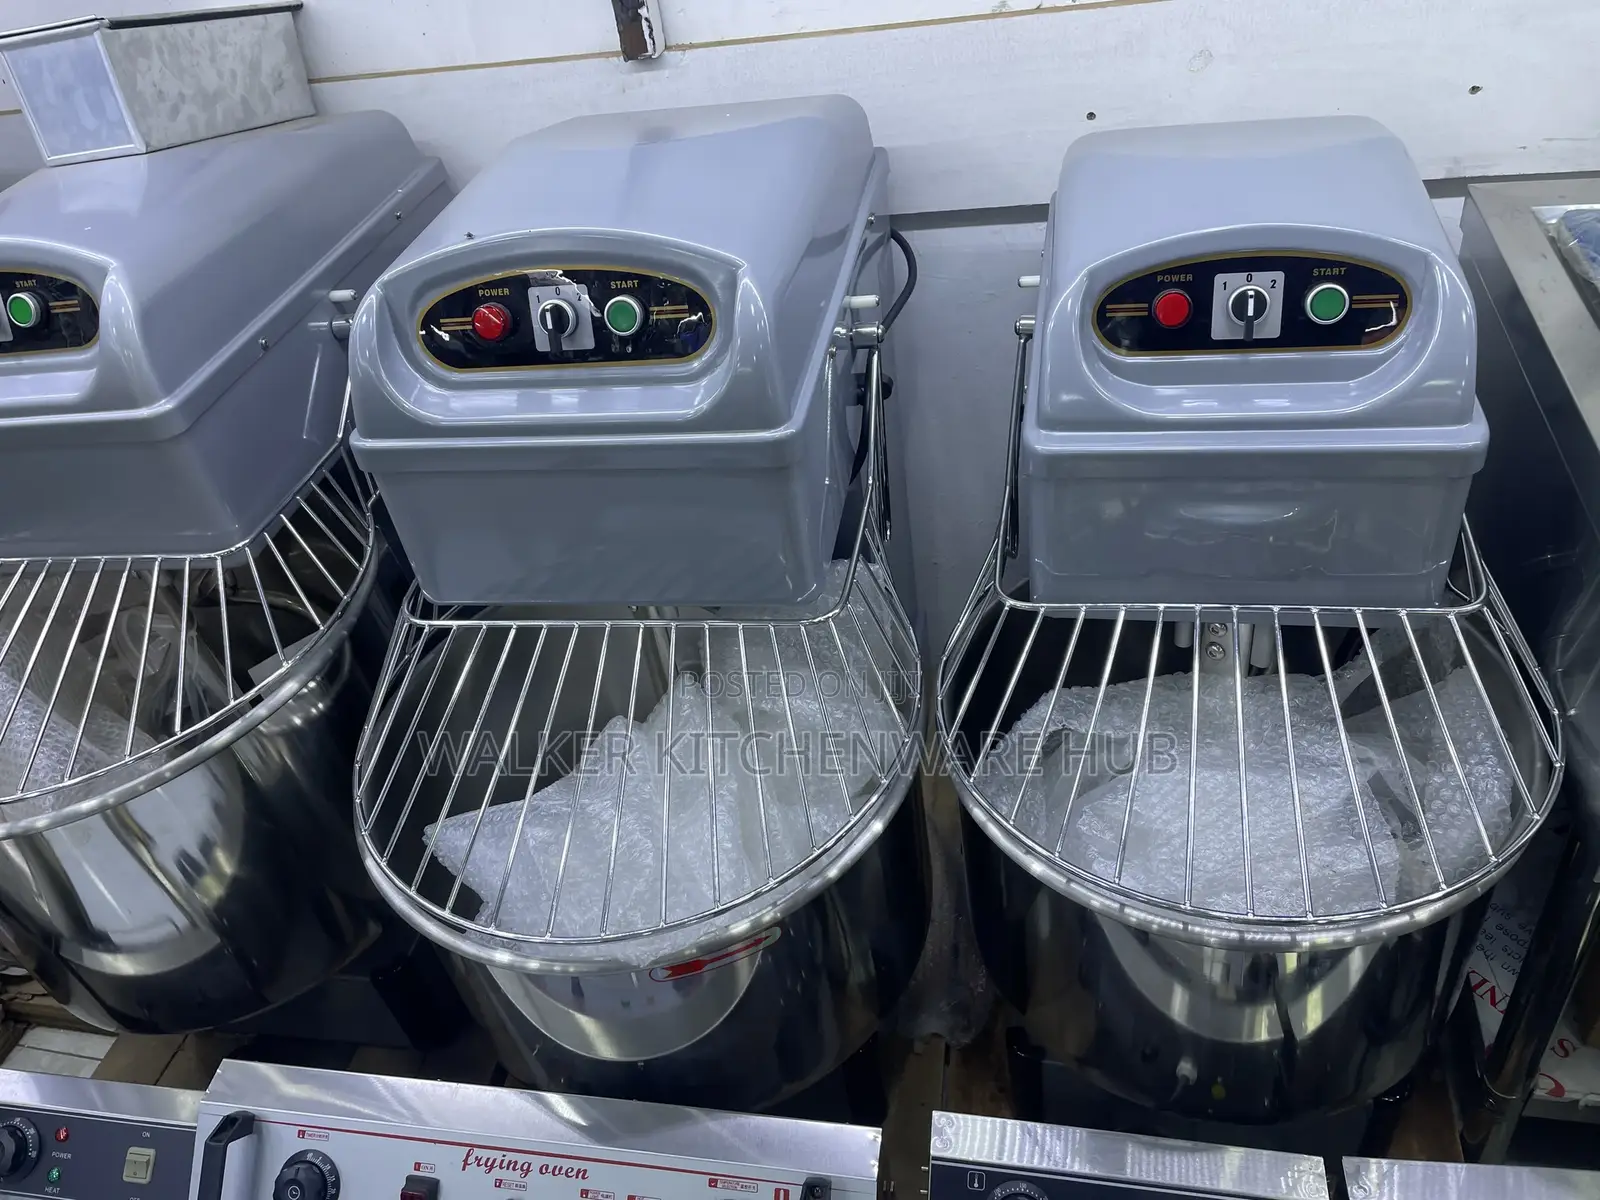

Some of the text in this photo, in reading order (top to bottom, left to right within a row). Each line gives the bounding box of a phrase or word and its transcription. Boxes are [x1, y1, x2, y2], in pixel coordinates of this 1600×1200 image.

[1312, 267, 1347, 277] START
[1157, 273, 1193, 283] POWER
[1223, 273, 1277, 291] 1 0 2
[15, 279, 37, 288] START
[610, 279, 639, 289] START
[478, 287, 510, 297] POWER
[536, 286, 582, 304] 1 0 2
[51, 1151, 72, 1160] POWER
[461, 1147, 590, 1180] frying oven
[44, 1186, 61, 1195] HEAT
